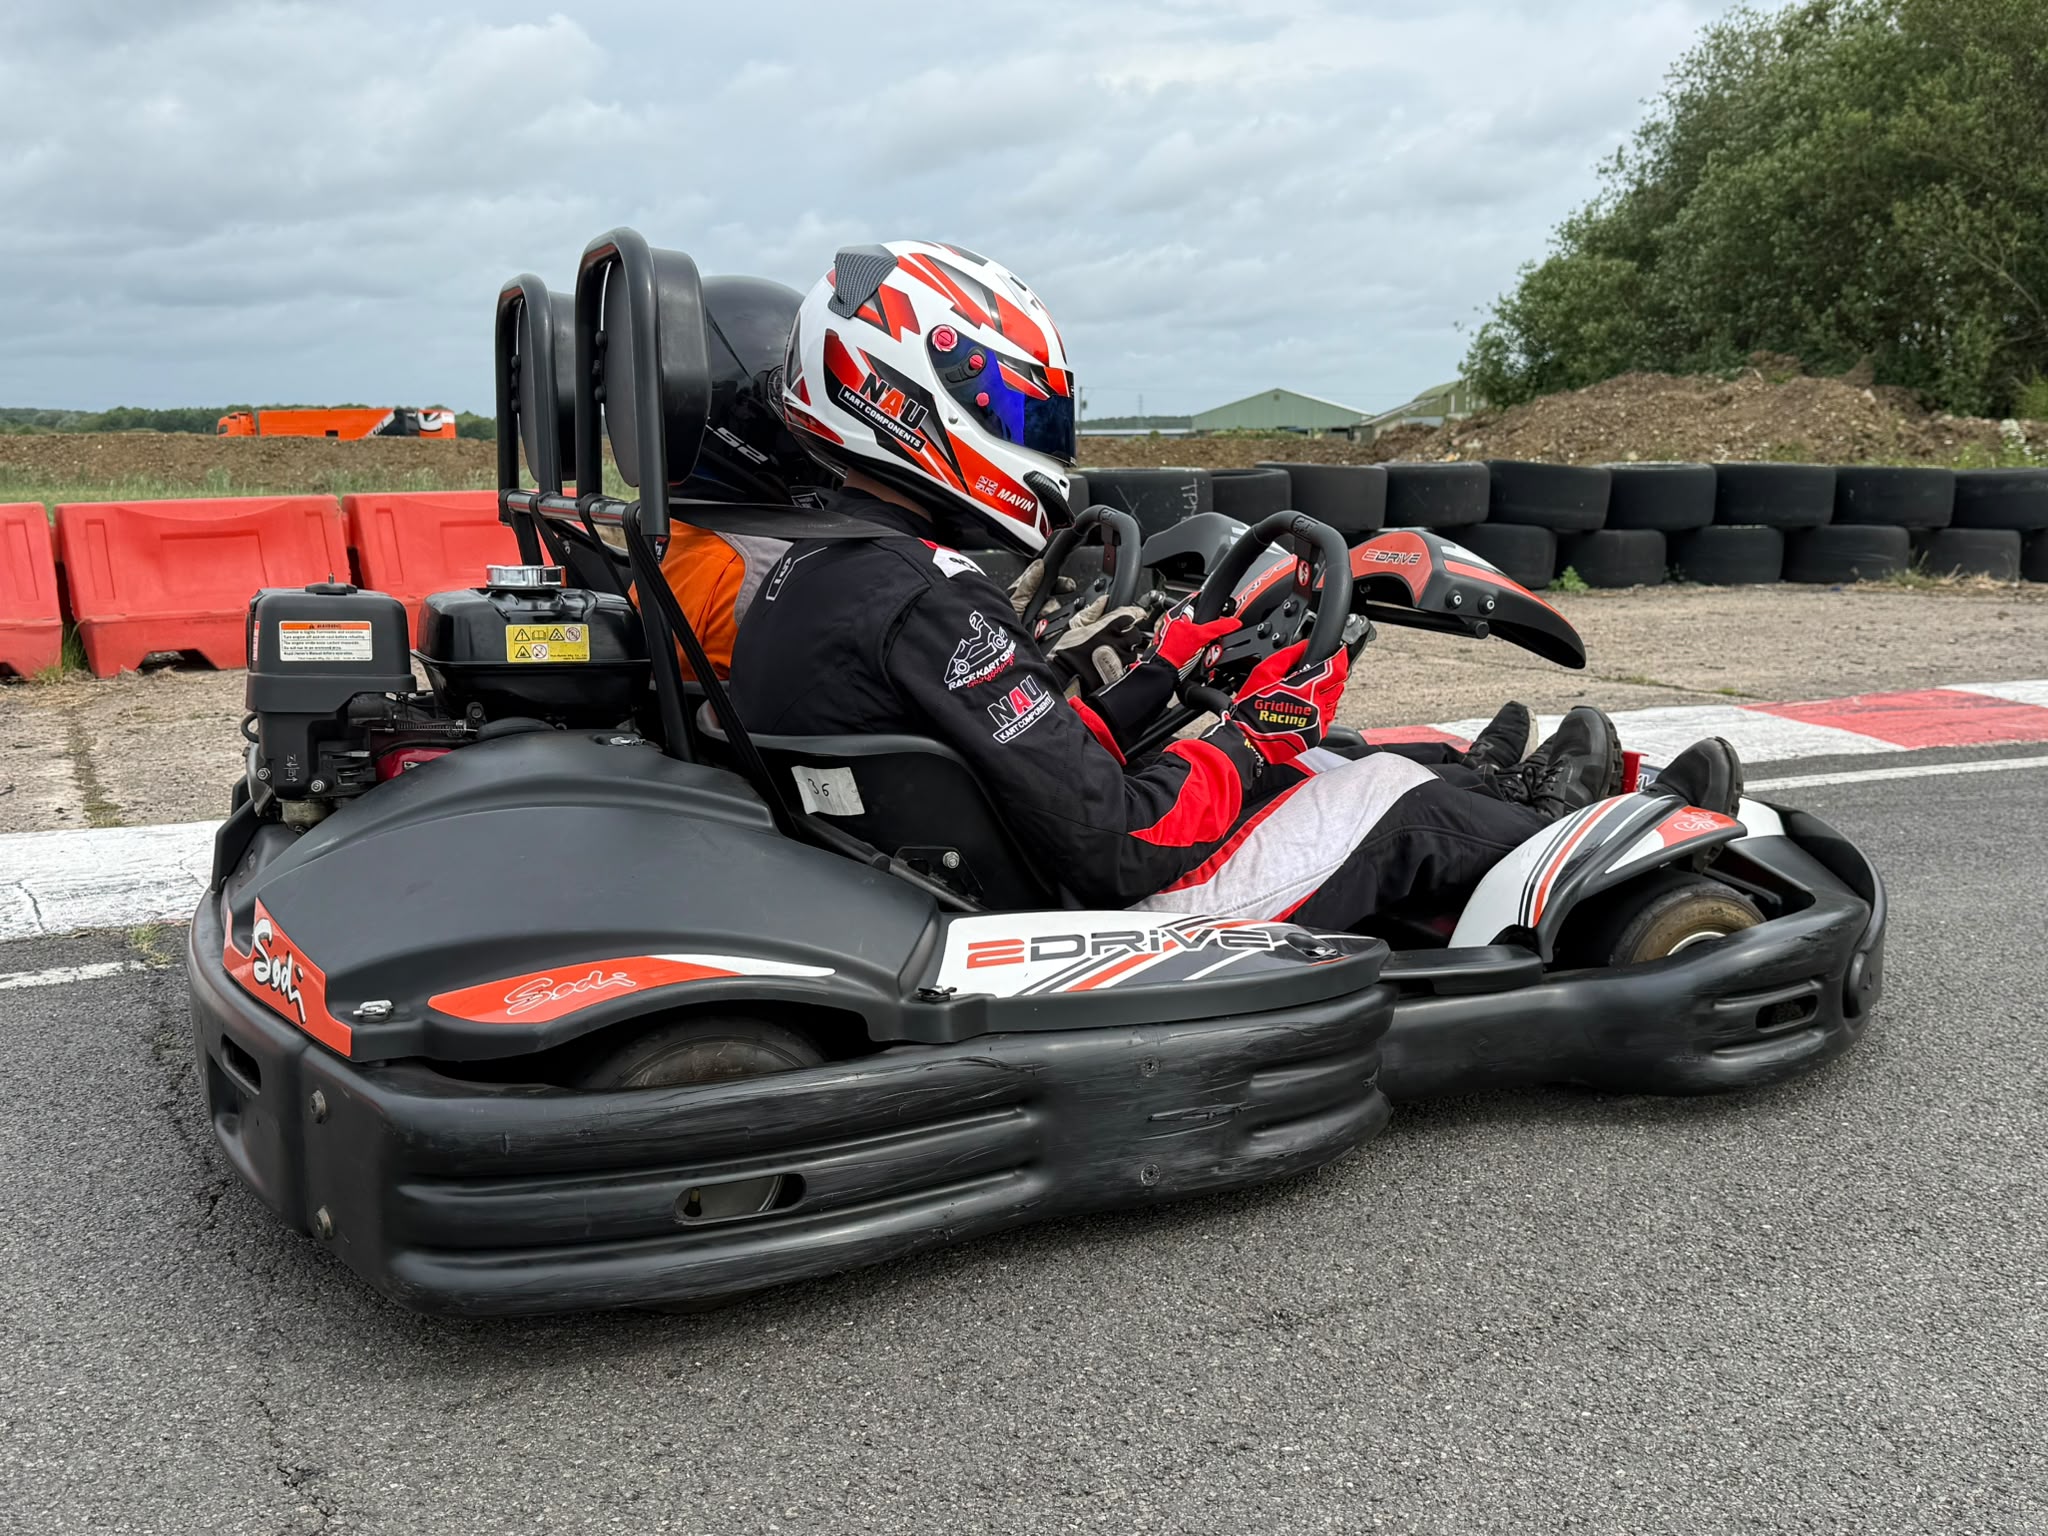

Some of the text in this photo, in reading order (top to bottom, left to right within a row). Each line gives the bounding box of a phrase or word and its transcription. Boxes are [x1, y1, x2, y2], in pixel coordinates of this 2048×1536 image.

[857, 371, 929, 431] NAU
[843, 390, 922, 448] KART COMPONENTS
[997, 488, 1035, 512] MAVIN
[948, 672, 977, 691] RACE
[976, 658, 1000, 678] KART
[987, 674, 1043, 728] NAU
[1254, 699, 1313, 716] Gridline
[999, 723, 1020, 740] KART
[1259, 710, 1308, 727] Racing
